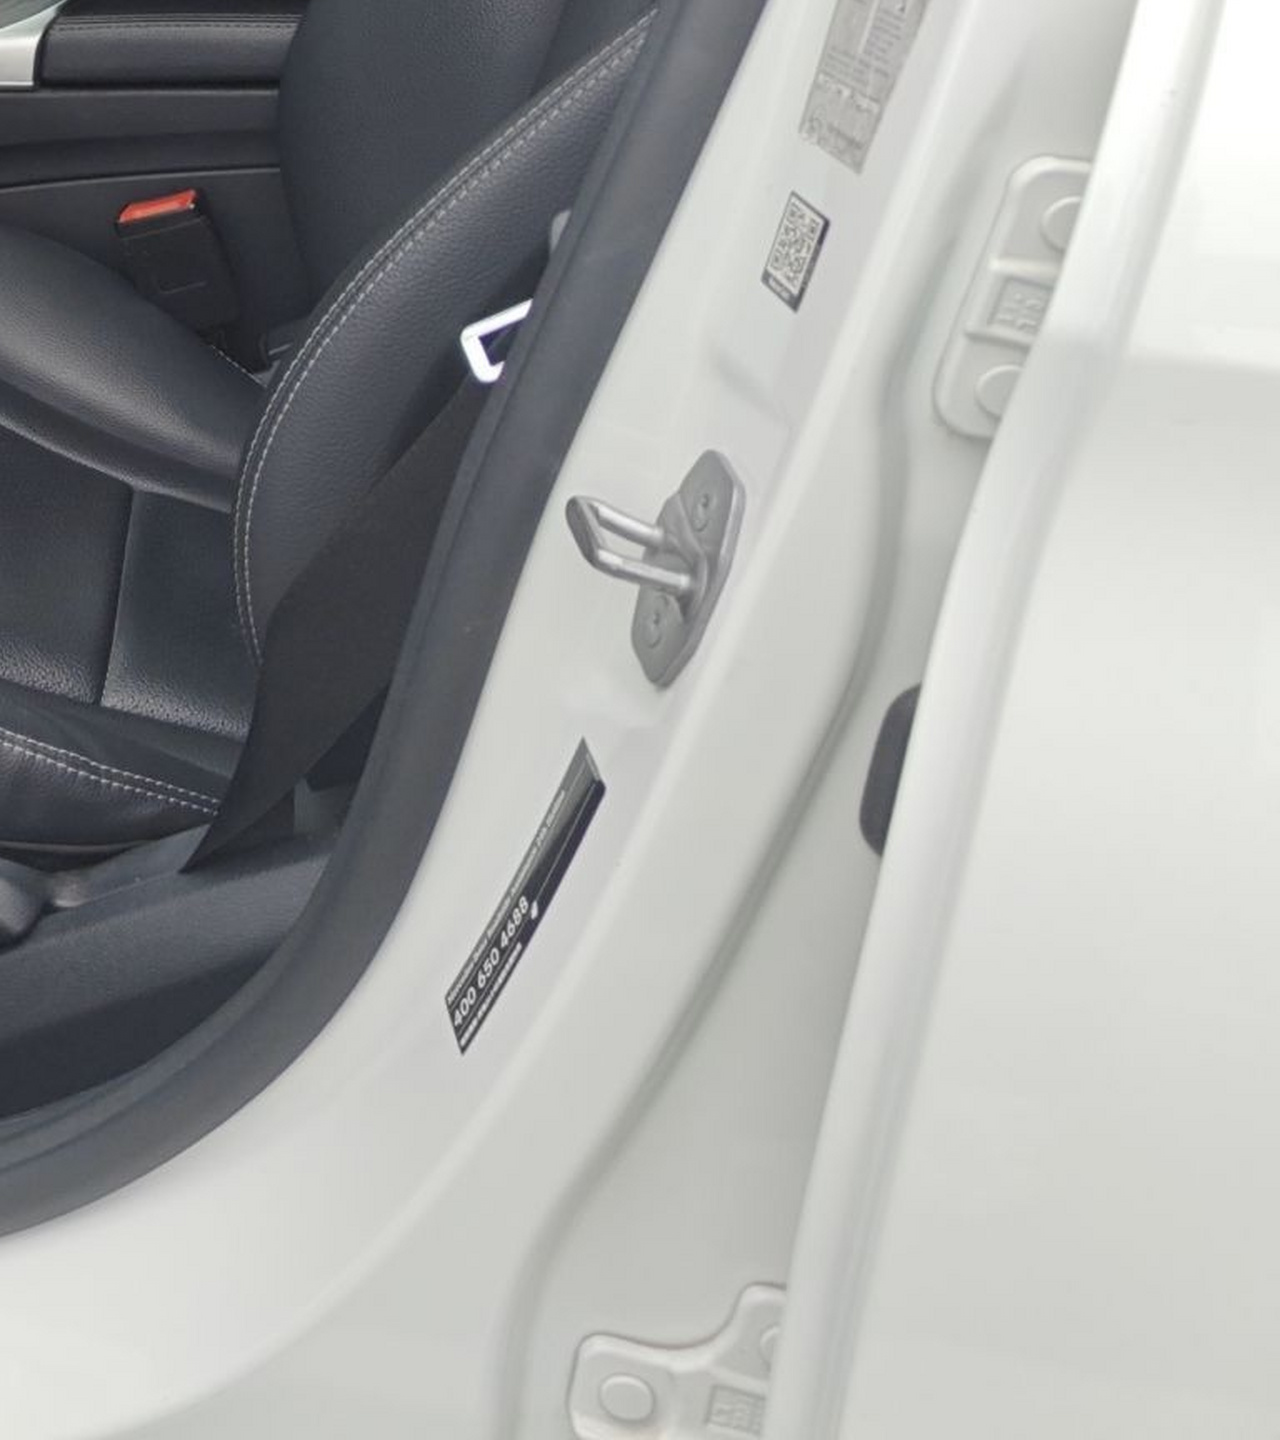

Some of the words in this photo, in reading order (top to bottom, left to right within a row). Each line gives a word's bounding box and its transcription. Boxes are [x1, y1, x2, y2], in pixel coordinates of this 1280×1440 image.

[453, 986, 477, 1028] 400
[476, 947, 501, 990] 650
[499, 894, 530, 948] 4688
